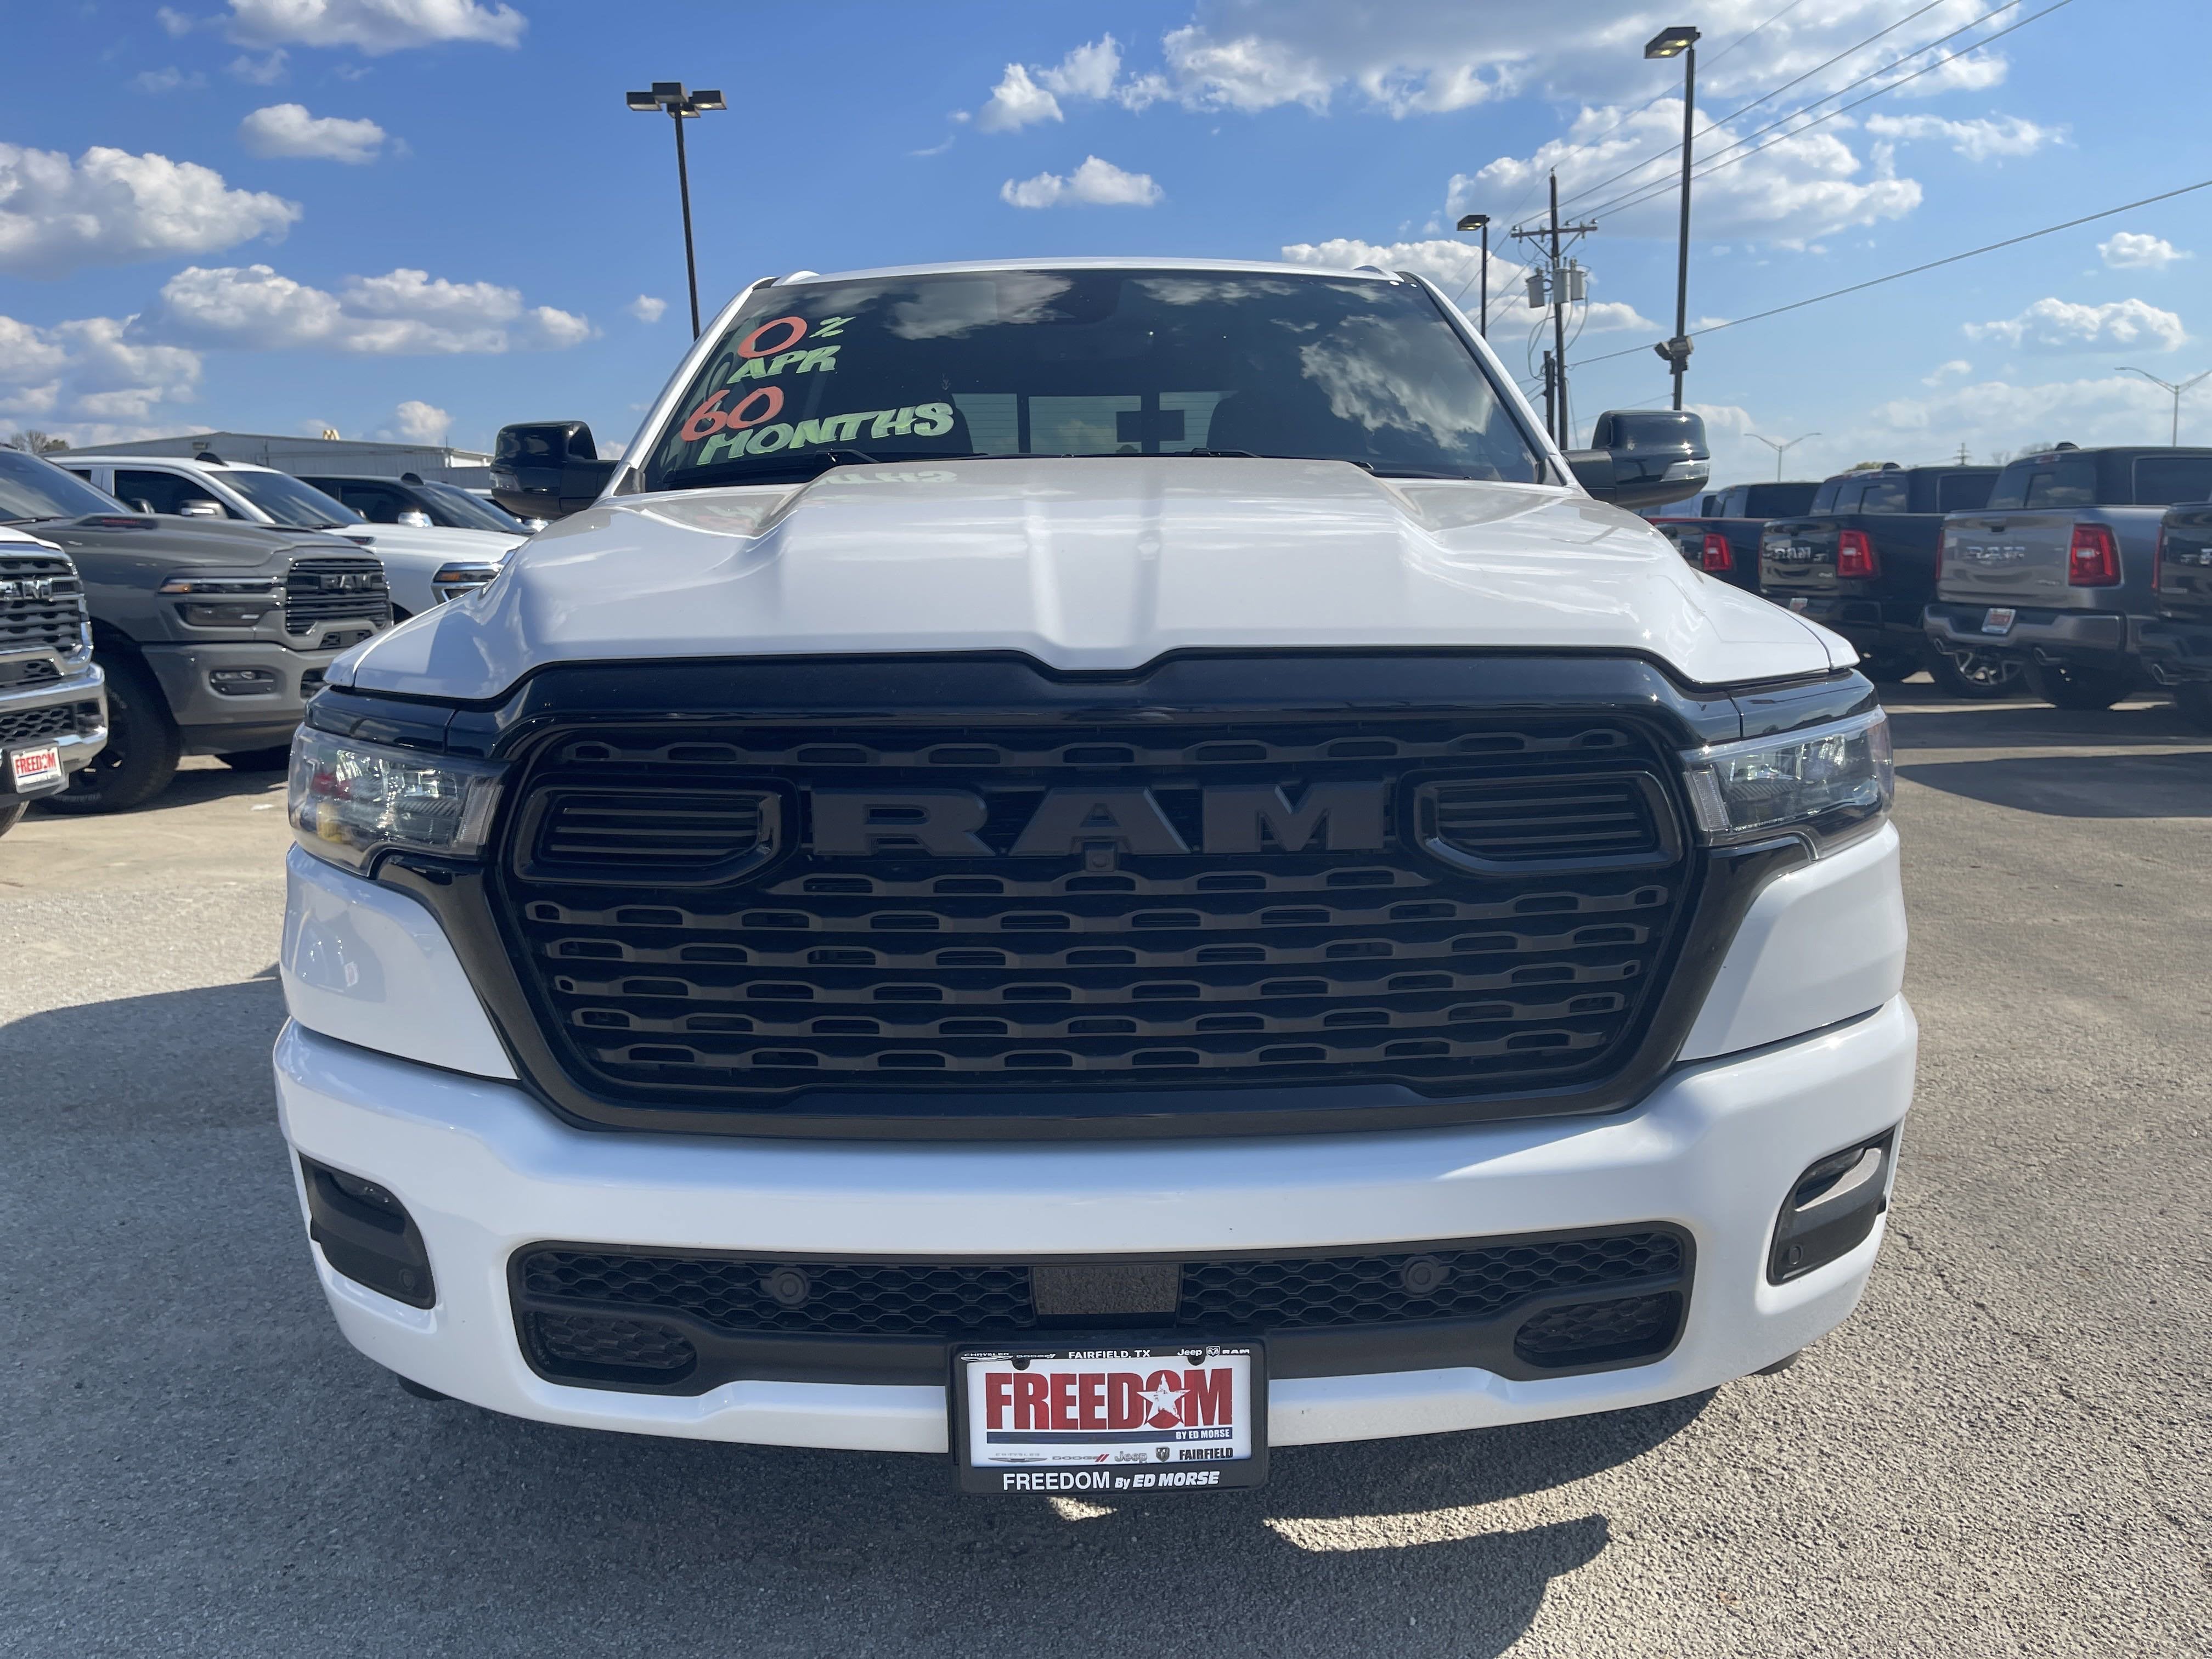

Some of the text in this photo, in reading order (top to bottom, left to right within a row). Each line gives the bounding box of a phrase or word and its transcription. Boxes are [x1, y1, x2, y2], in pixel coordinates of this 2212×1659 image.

[726, 345, 840, 383] APR
[681, 386, 784, 442] 60
[696, 402, 953, 465] MONTHS
[15, 752, 57, 775] FREEDOM
[811, 781, 1386, 856] RAM
[1134, 1349, 1150, 1358] TX
[1177, 1348, 1203, 1357] Jeep
[985, 1368, 1233, 1430] FREEDOM
[1176, 1429, 1230, 1440] BY ED MORSE
[1114, 1451, 1148, 1464] Jeep
[1179, 1447, 1234, 1460] FAIRFIELD
[1003, 1471, 1221, 1491] FREEDOM By ED MORSE
